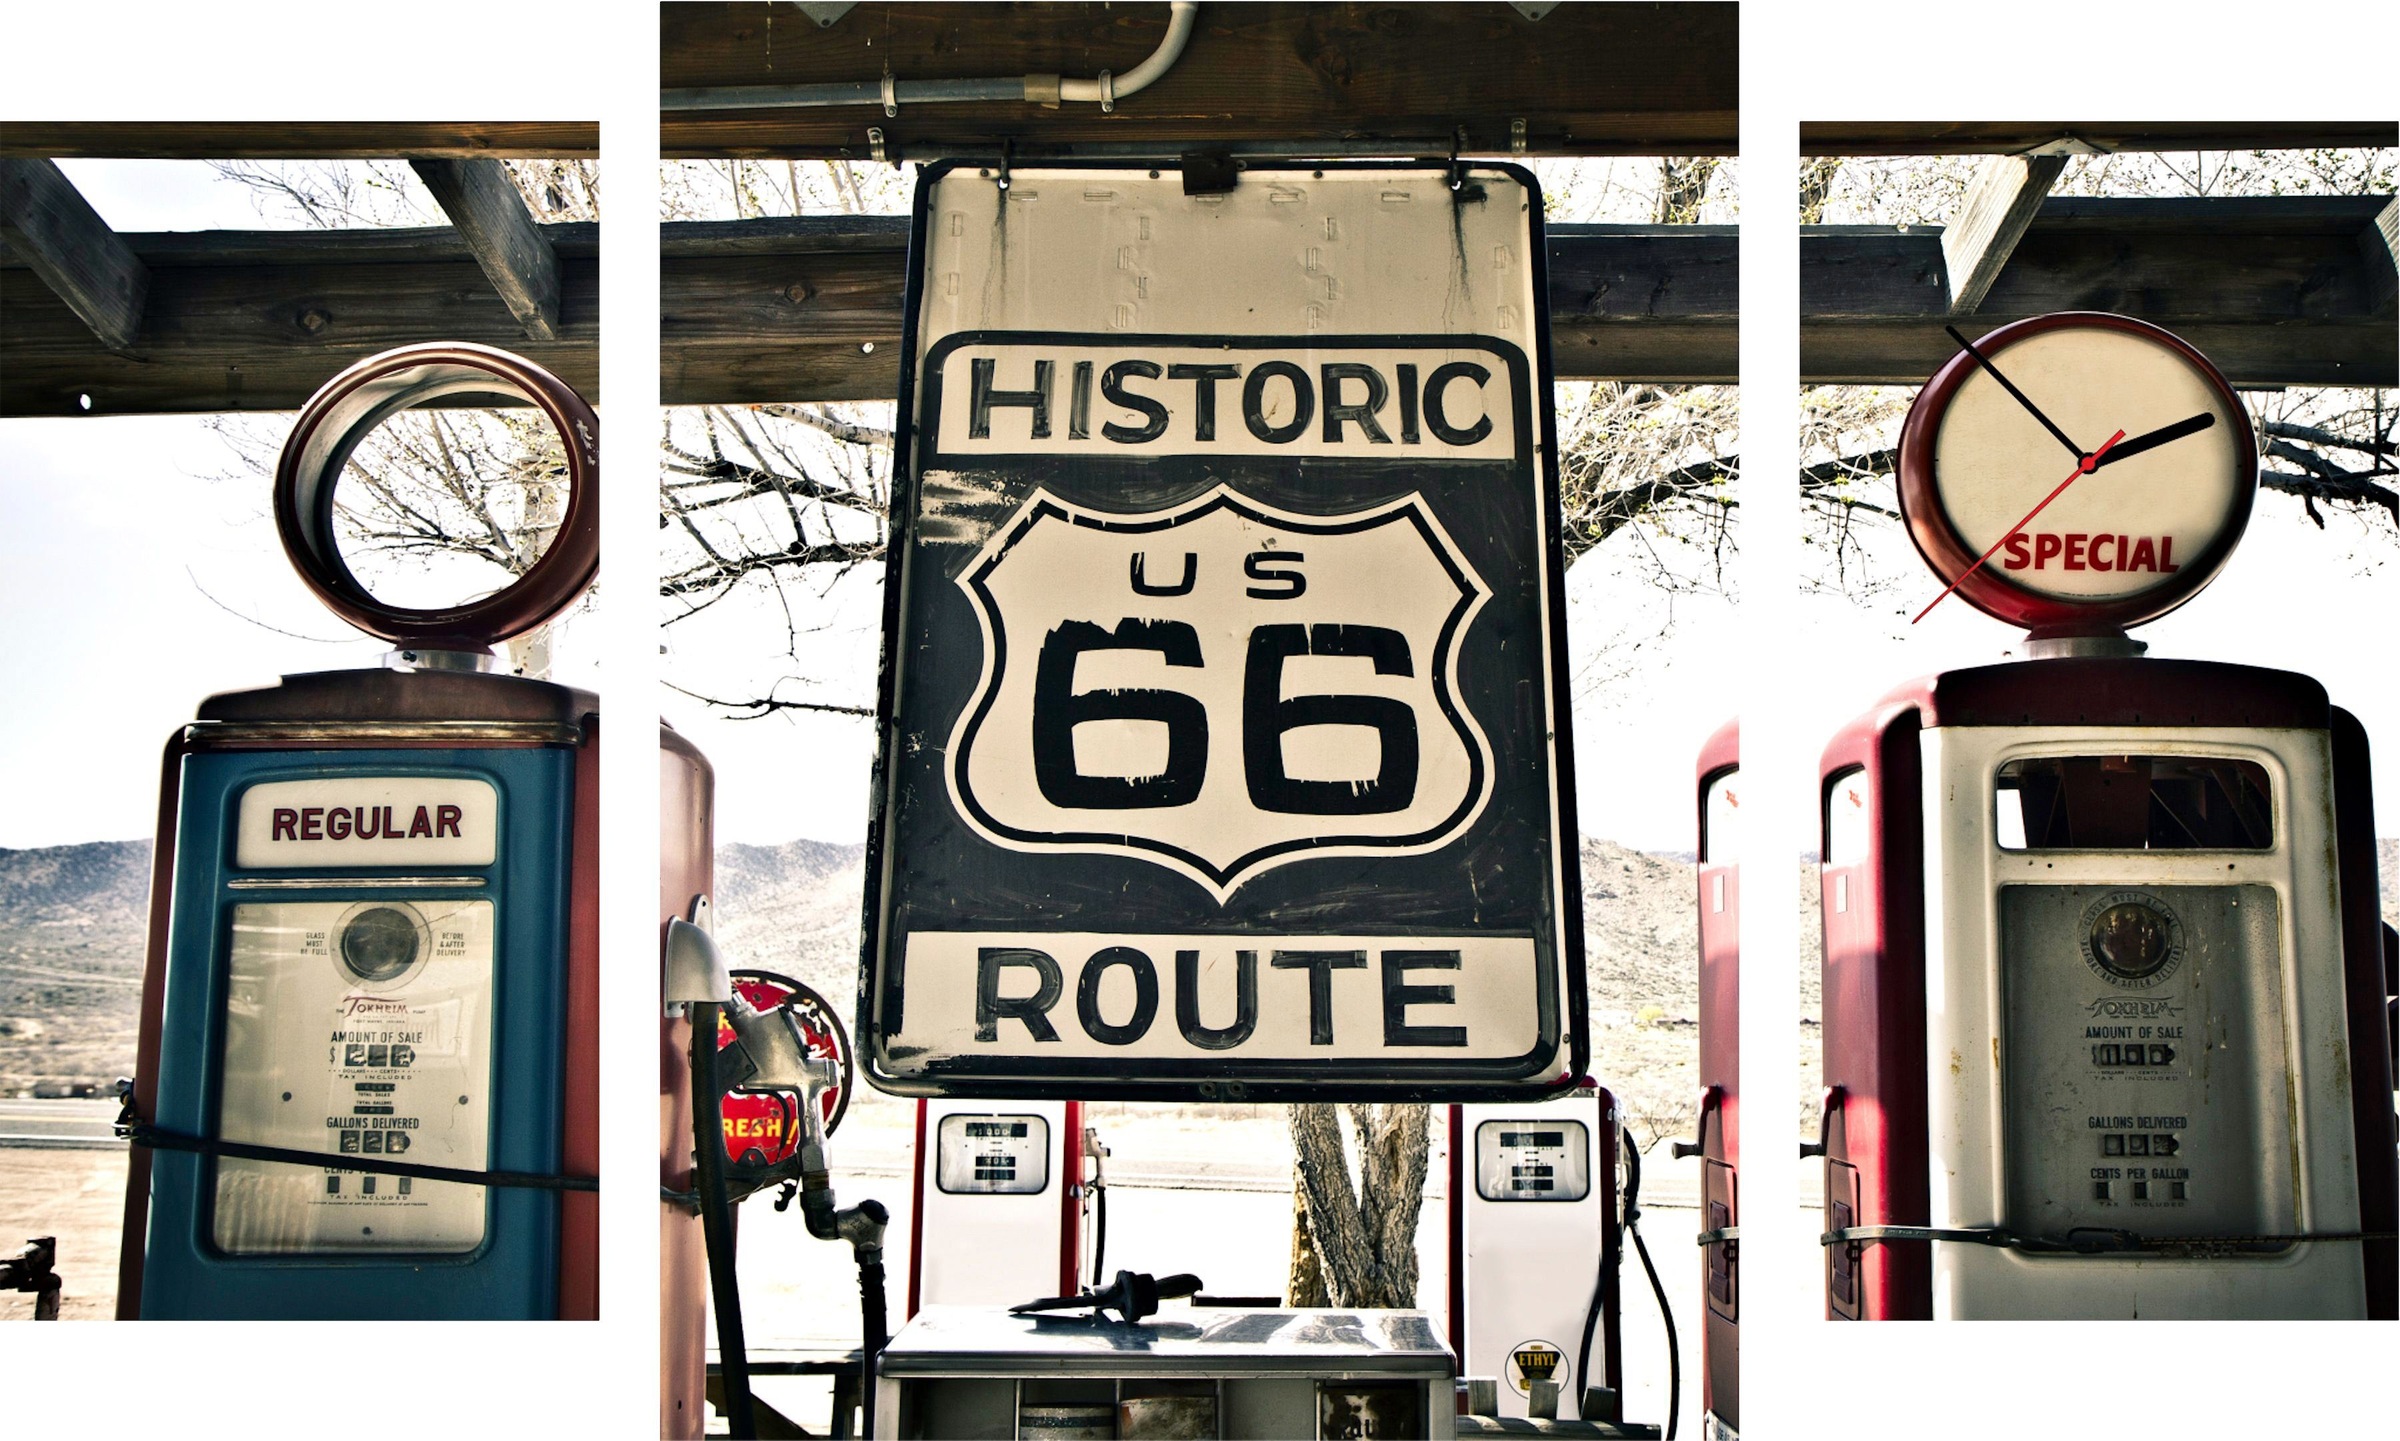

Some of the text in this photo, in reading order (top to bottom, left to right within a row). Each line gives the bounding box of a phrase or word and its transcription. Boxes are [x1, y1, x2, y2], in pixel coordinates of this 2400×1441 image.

[968, 357, 1494, 447] HISTORIC
[2003, 533, 2180, 573] SPECIAL
[1032, 617, 1420, 816] 66
[272, 804, 462, 841] REGULAR
[2121, 980, 2152, 989] AFTER
[974, 946, 1469, 1051] ROUTE
[342, 995, 408, 1019] TOKHEIM
[330, 1031, 423, 1043] AMOUNT OF SALE
[2085, 1026, 2184, 1039] AMOUNT OF SALE
[329, 1046, 336, 1065] $
[326, 1117, 420, 1129] GALLONS DELIVERED
[2088, 1116, 2188, 1129] GALLONS DELIVERED
[2090, 1168, 2190, 1179] CENTS PER GALLON
[1519, 1353, 1556, 1366] ETHYL
